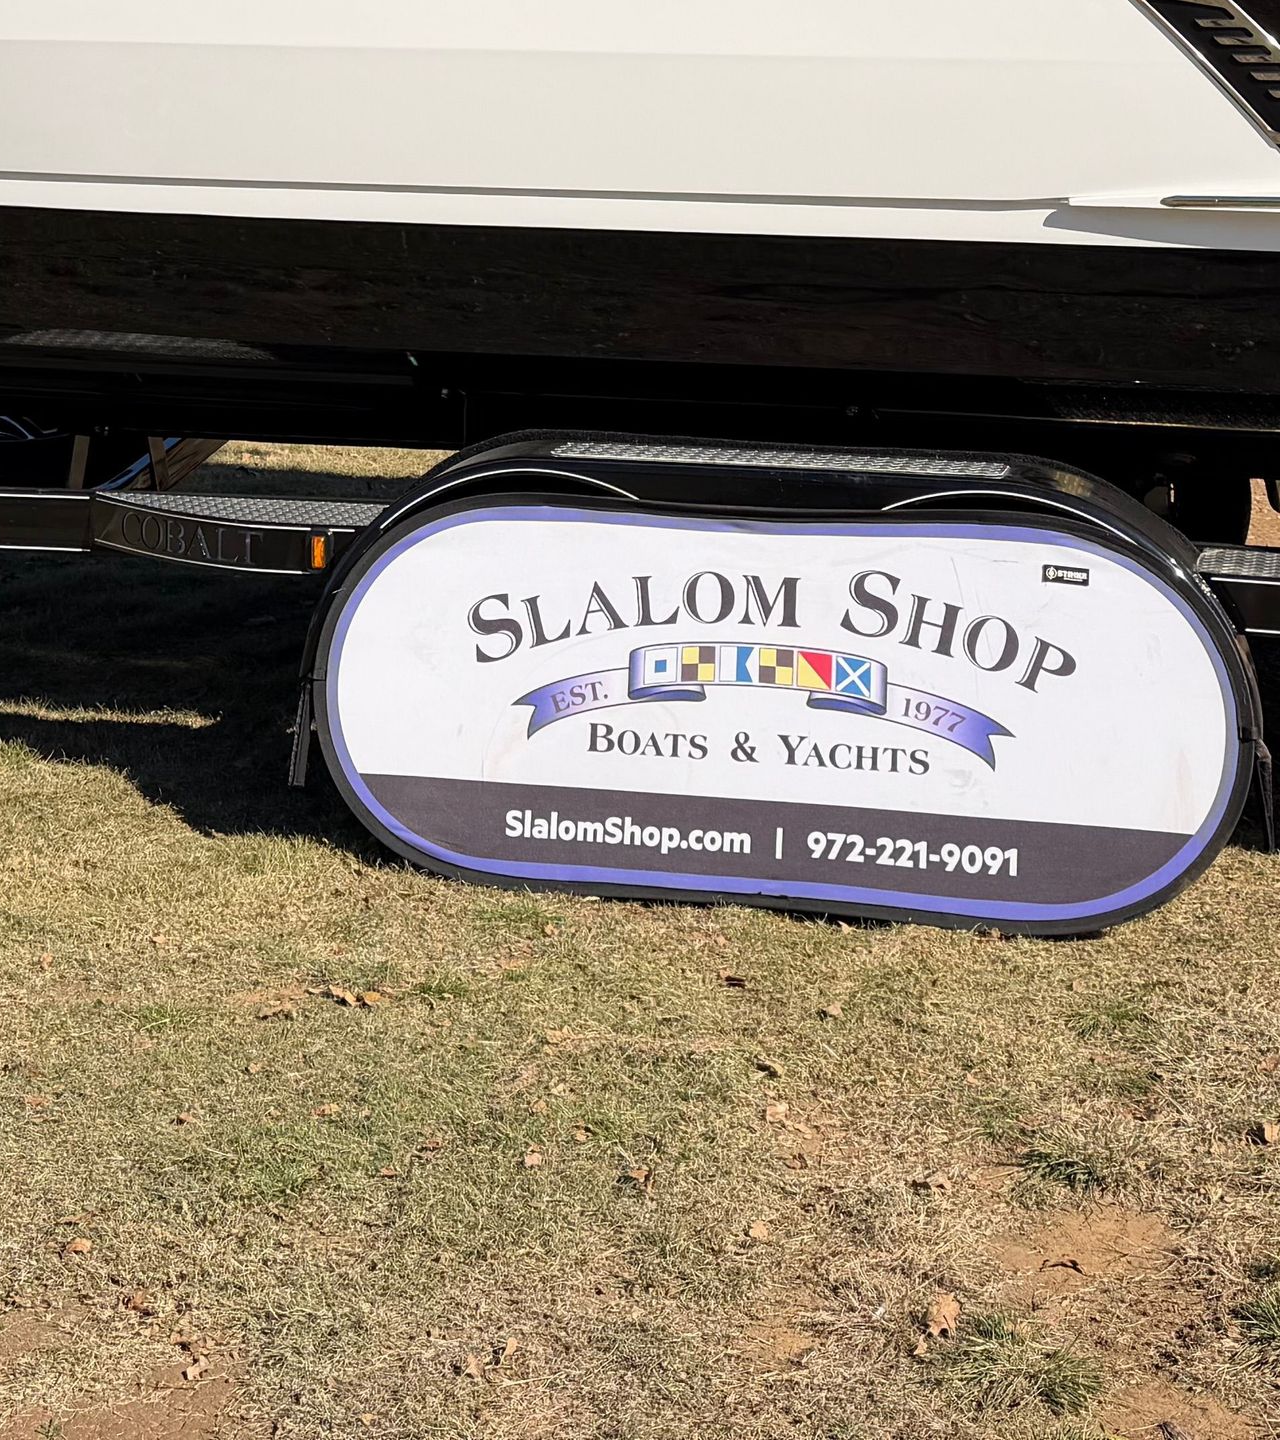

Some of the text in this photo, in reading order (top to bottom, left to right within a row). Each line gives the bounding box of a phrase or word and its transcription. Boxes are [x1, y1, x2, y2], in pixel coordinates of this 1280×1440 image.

[122, 511, 264, 565] COBALT
[467, 569, 1077, 694] SLALOM SHOP
[549, 680, 967, 733] EST. 1977
[587, 722, 931, 776] BOATS & YACHTS
[505, 809, 752, 855] SlalomShop.com
[806, 830, 1019, 877] 972-221-9091
